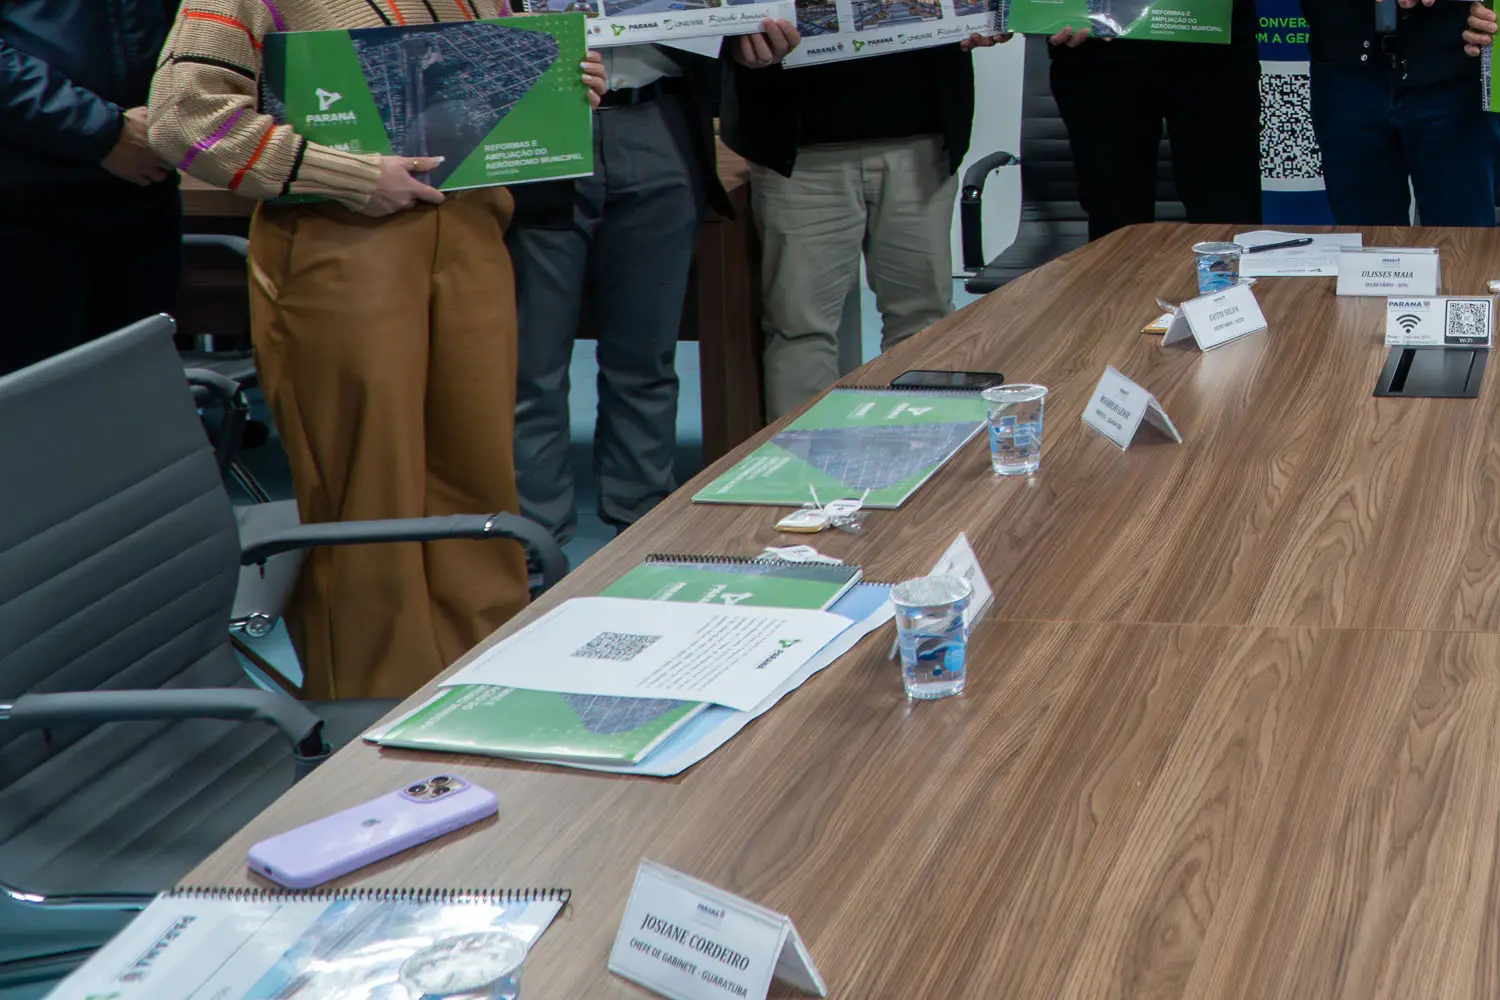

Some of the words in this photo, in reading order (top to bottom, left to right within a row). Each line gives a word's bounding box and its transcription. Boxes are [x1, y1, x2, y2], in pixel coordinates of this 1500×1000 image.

[806, 45, 837, 56] PARANÁ
[306, 110, 357, 123] PARANÁ
[1361, 270, 1393, 279] ULISSES
[1392, 271, 1415, 279] MAIA
[640, 912, 691, 945] JOSIANE
[687, 932, 751, 972] CORDEIRO
[629, 935, 653, 956] CHEFE
[651, 945, 662, 960] DE
[661, 951, 697, 976] GABINETE
[701, 968, 749, 999] GUARATUBA
